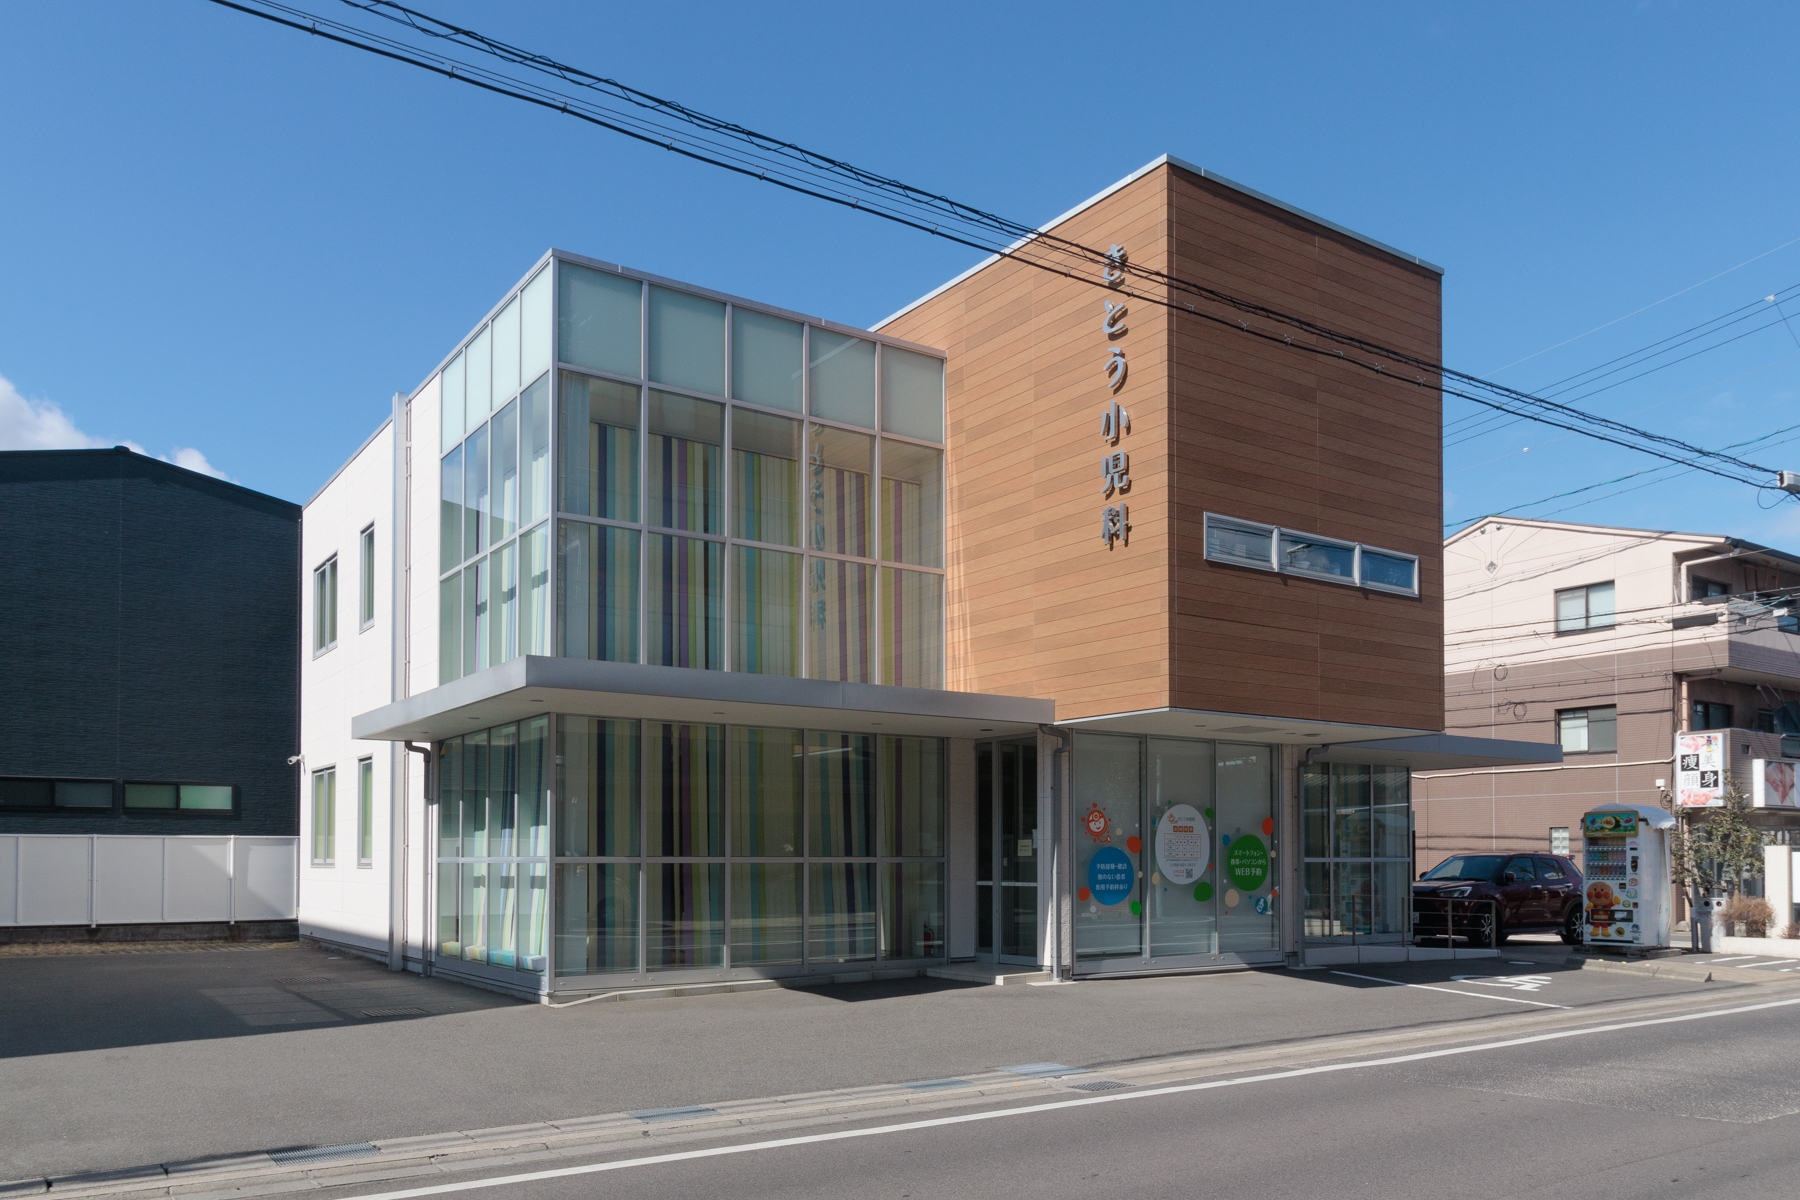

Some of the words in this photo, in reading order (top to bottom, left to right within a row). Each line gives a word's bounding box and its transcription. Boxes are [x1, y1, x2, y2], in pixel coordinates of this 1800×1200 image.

[1100, 243, 1129, 545] きとう小児科
[1234, 867, 1263, 876] WEB予約
